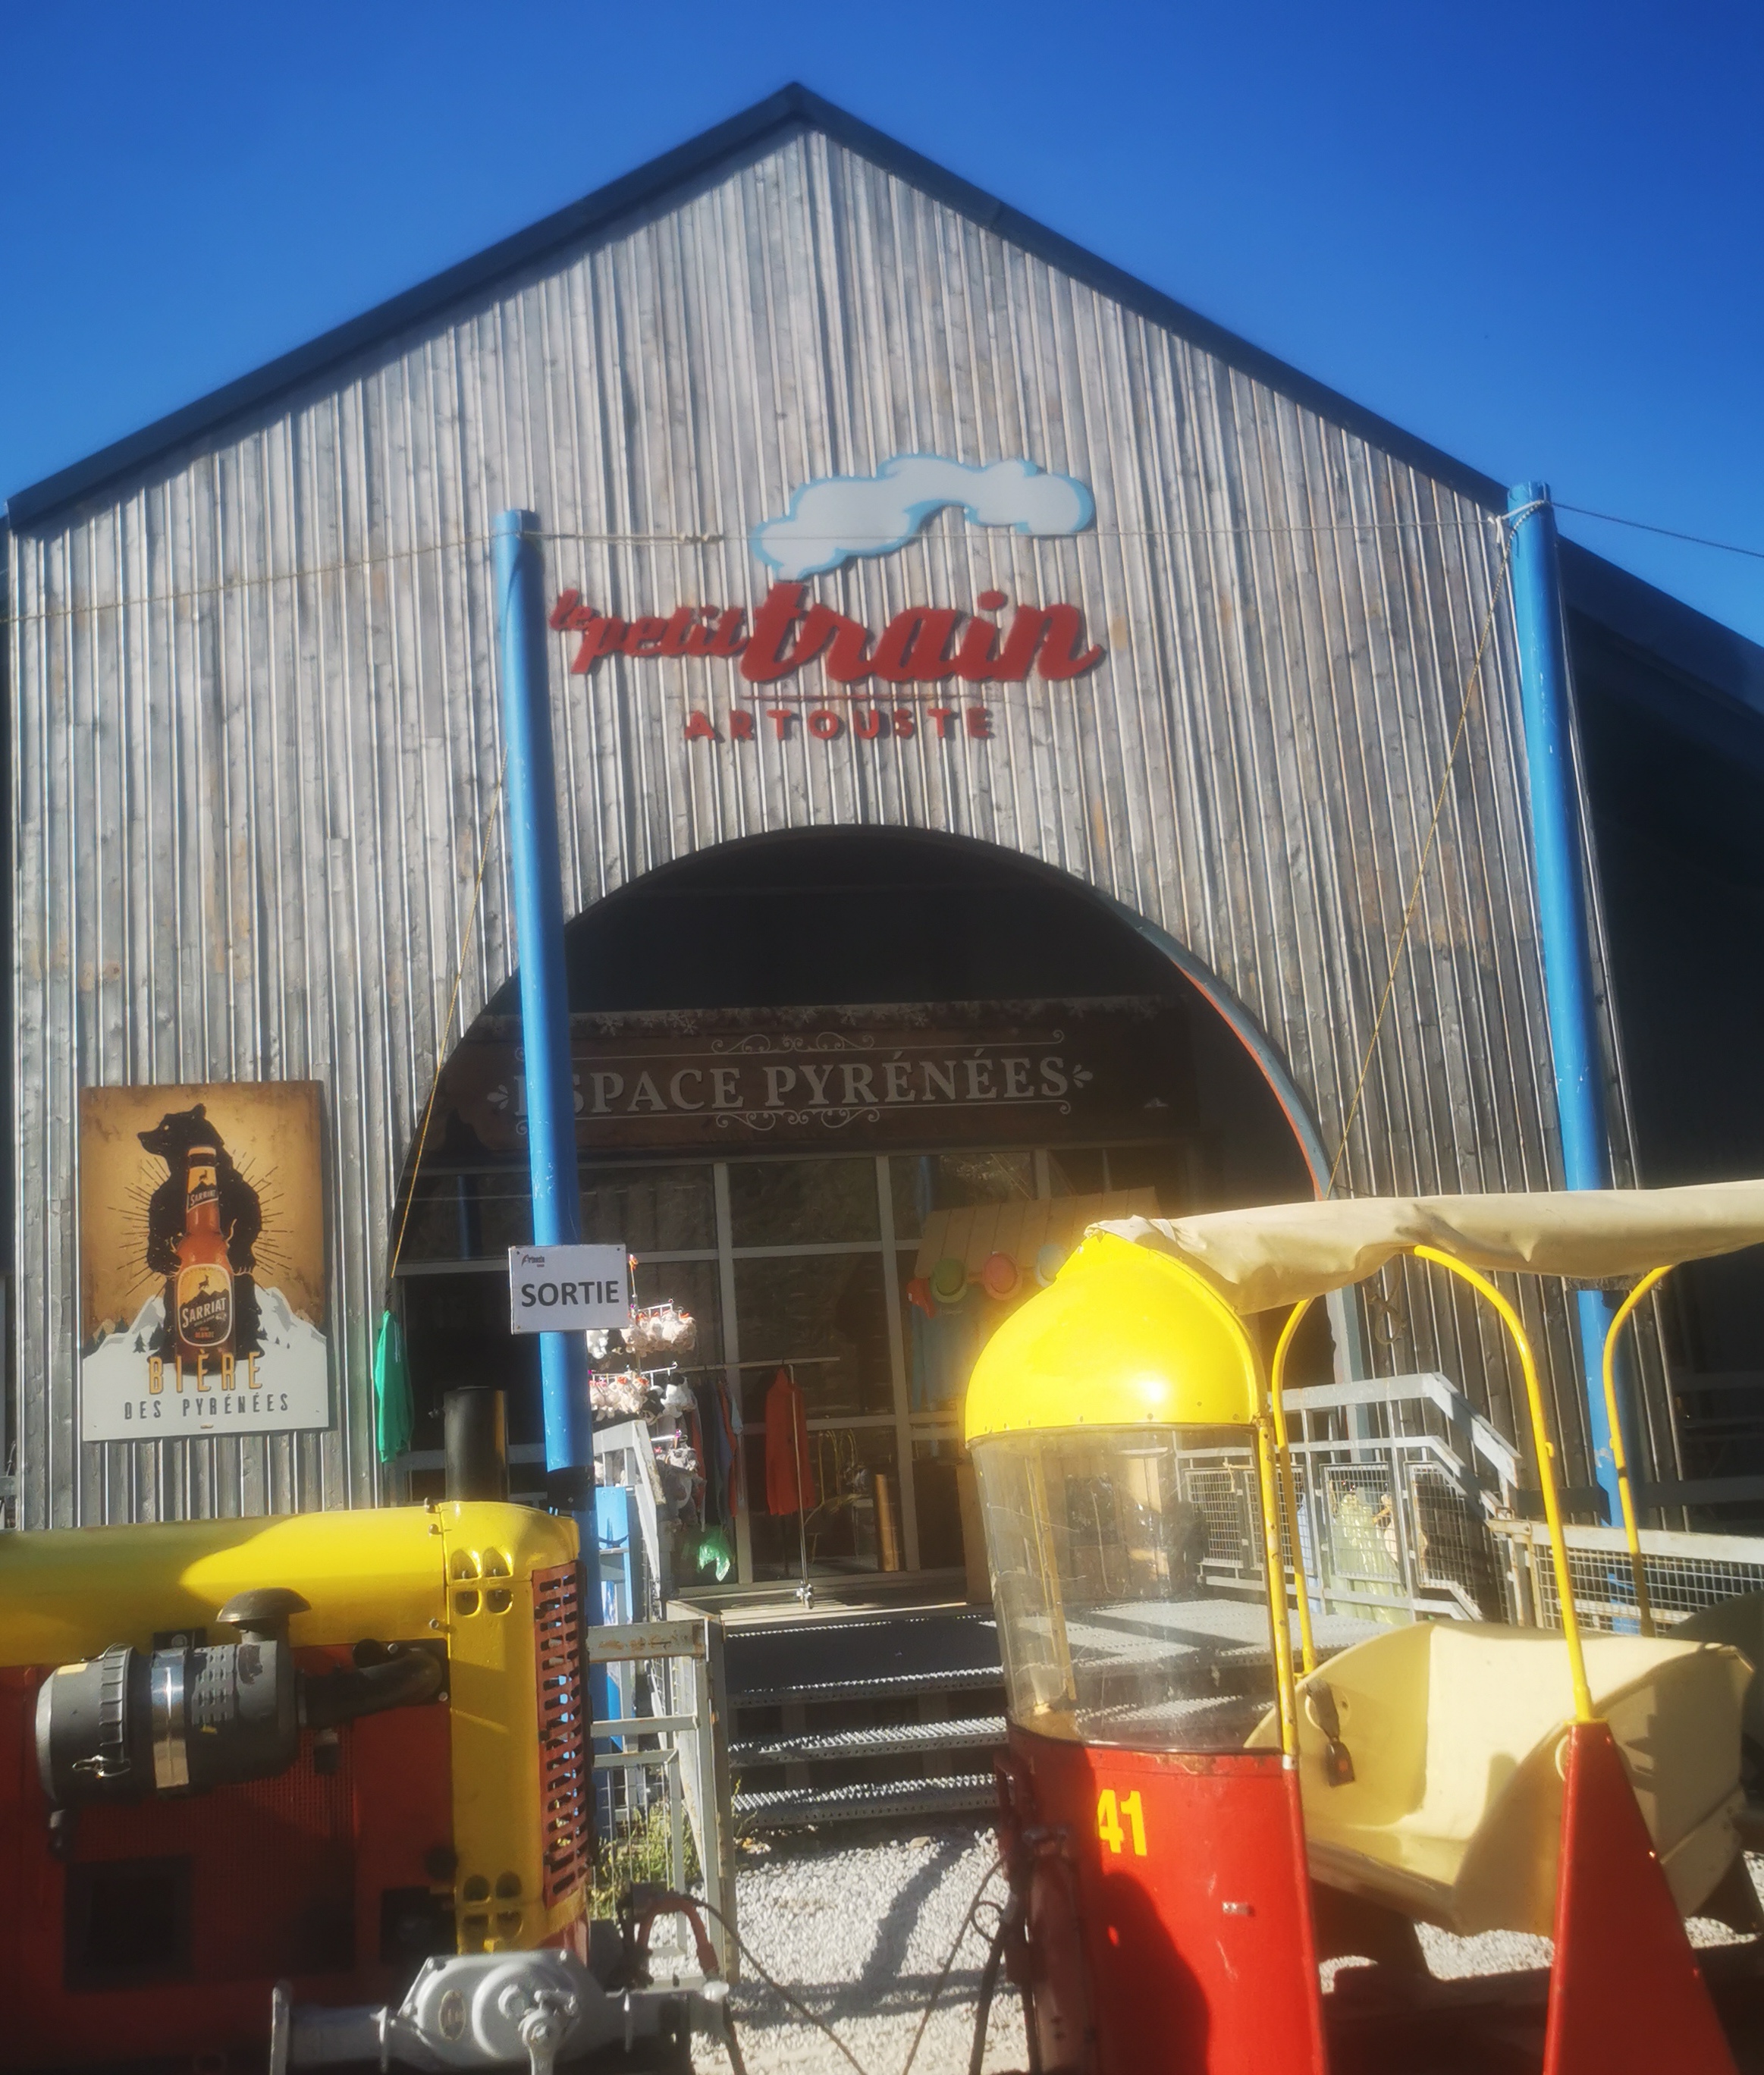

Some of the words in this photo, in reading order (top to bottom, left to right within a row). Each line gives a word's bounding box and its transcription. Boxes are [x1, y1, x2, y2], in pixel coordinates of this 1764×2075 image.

[550, 589, 592, 630] le
[571, 604, 746, 674] petit
[740, 582, 1103, 682] train
[685, 708, 990, 739] ARTOUSTE
[762, 1048, 1069, 1107] PYRÉNÉES
[182, 1297, 226, 1329] SARRIAT
[521, 1280, 620, 1307] SORTIE
[149, 1348, 262, 1395] BIÈRE
[124, 1400, 162, 1420] DES
[182, 1392, 288, 1417] PYRÉNÉES
[1097, 1788, 1147, 1857] 41
